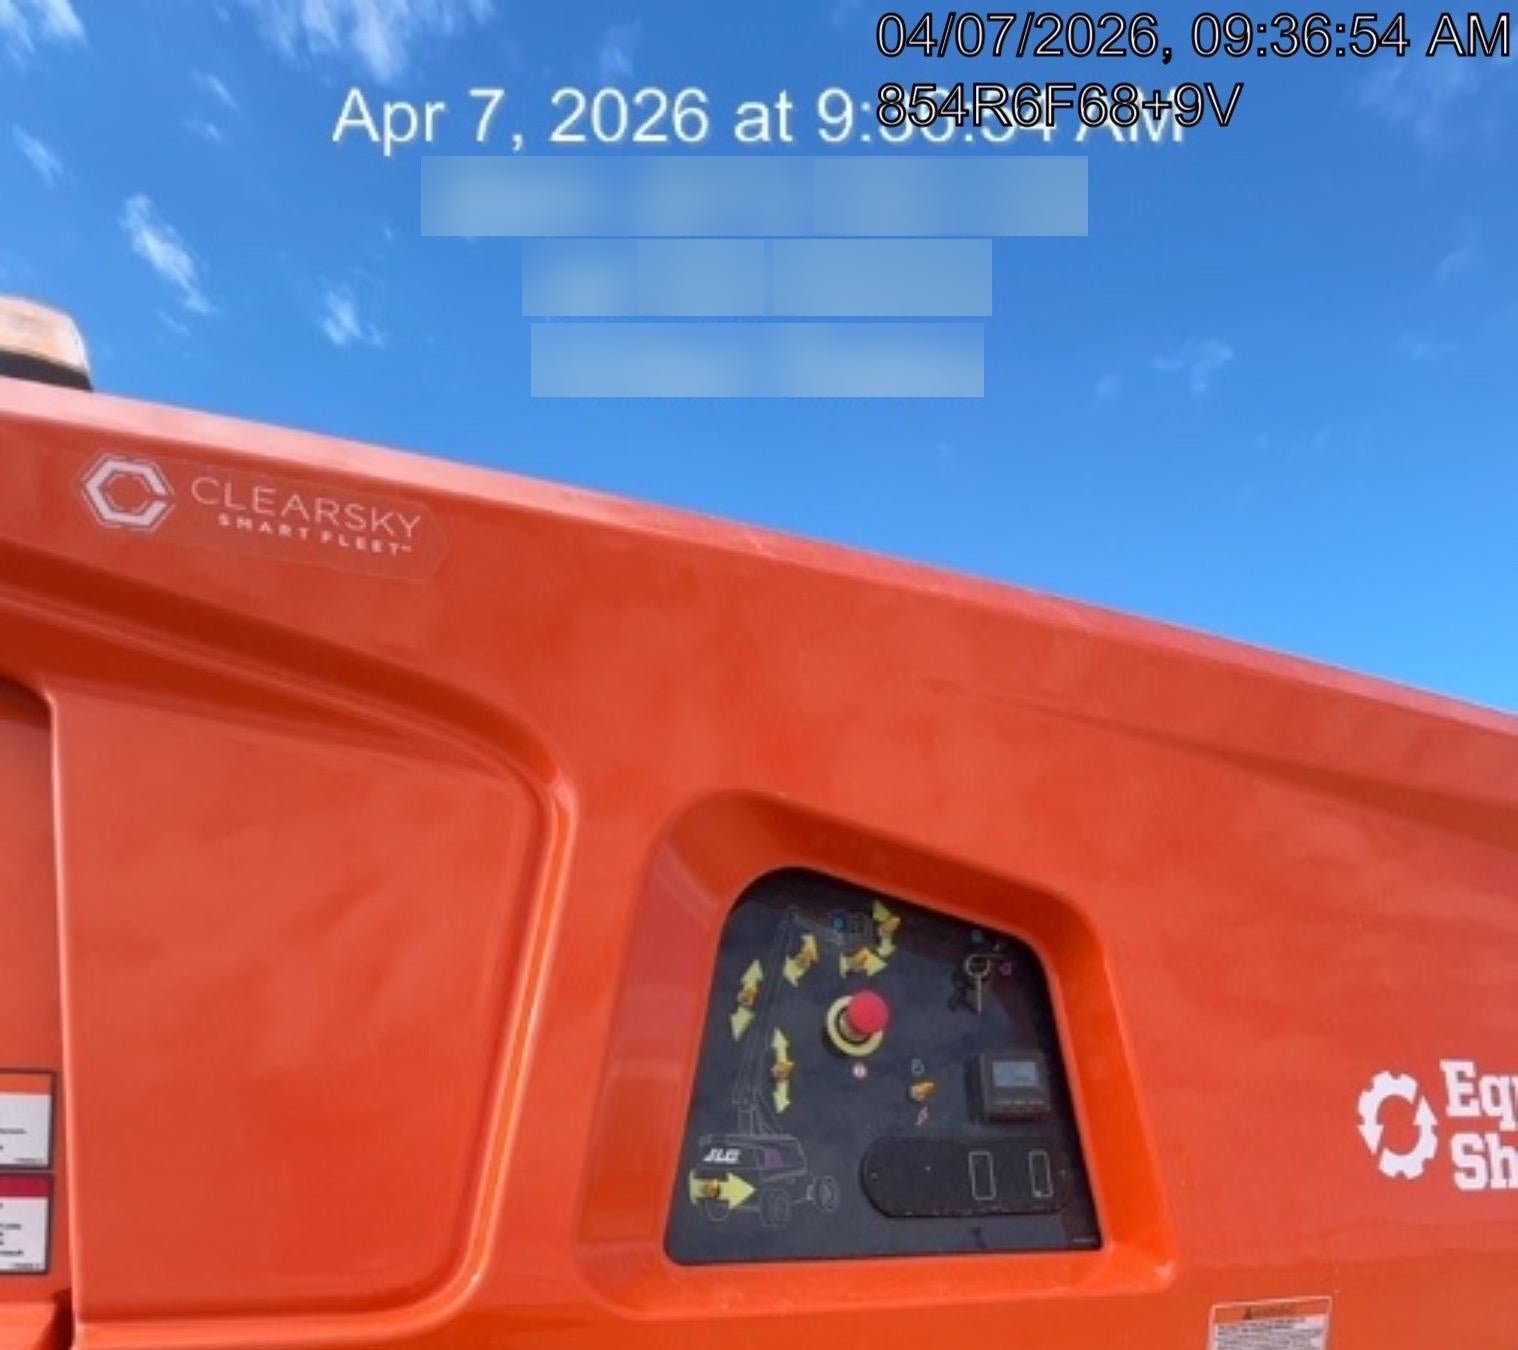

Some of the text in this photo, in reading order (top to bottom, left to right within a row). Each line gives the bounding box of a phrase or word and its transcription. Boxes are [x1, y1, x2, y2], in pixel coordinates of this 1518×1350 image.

[191, 476, 422, 539] CLEARSKY
[217, 511, 310, 541] SMART
[1439, 1058, 1518, 1131] Eq
